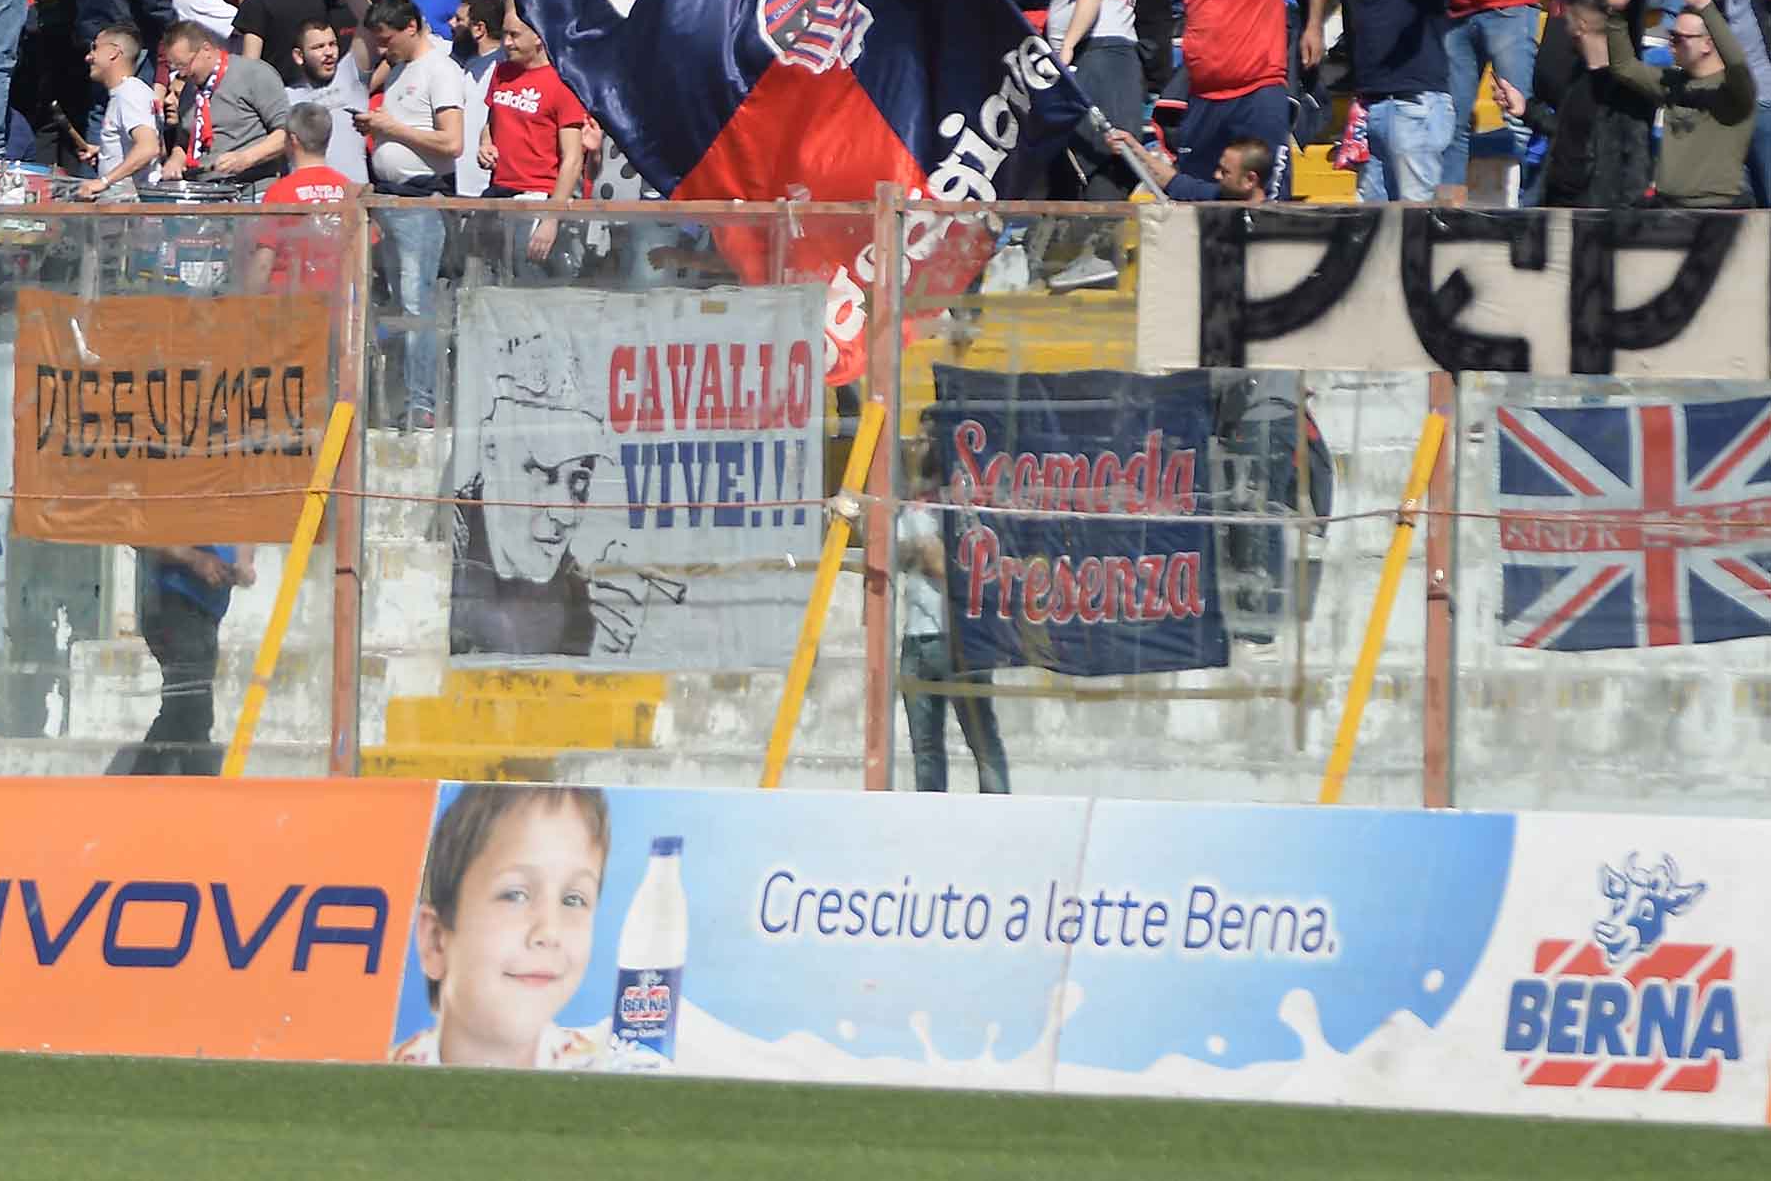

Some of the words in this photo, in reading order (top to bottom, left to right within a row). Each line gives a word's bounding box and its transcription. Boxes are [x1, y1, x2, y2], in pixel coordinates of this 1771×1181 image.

[492, 89, 541, 113] adidas
[608, 339, 814, 434] CAVALLO
[620, 438, 807, 530] VIVE!!!
[950, 419, 1199, 516] Scomoda
[956, 525, 1206, 625] Presenza
[758, 869, 990, 941] Cresciuto
[1003, 899, 1030, 944] a
[1043, 879, 1169, 949] latte
[1503, 977, 1743, 1061] BERNA
